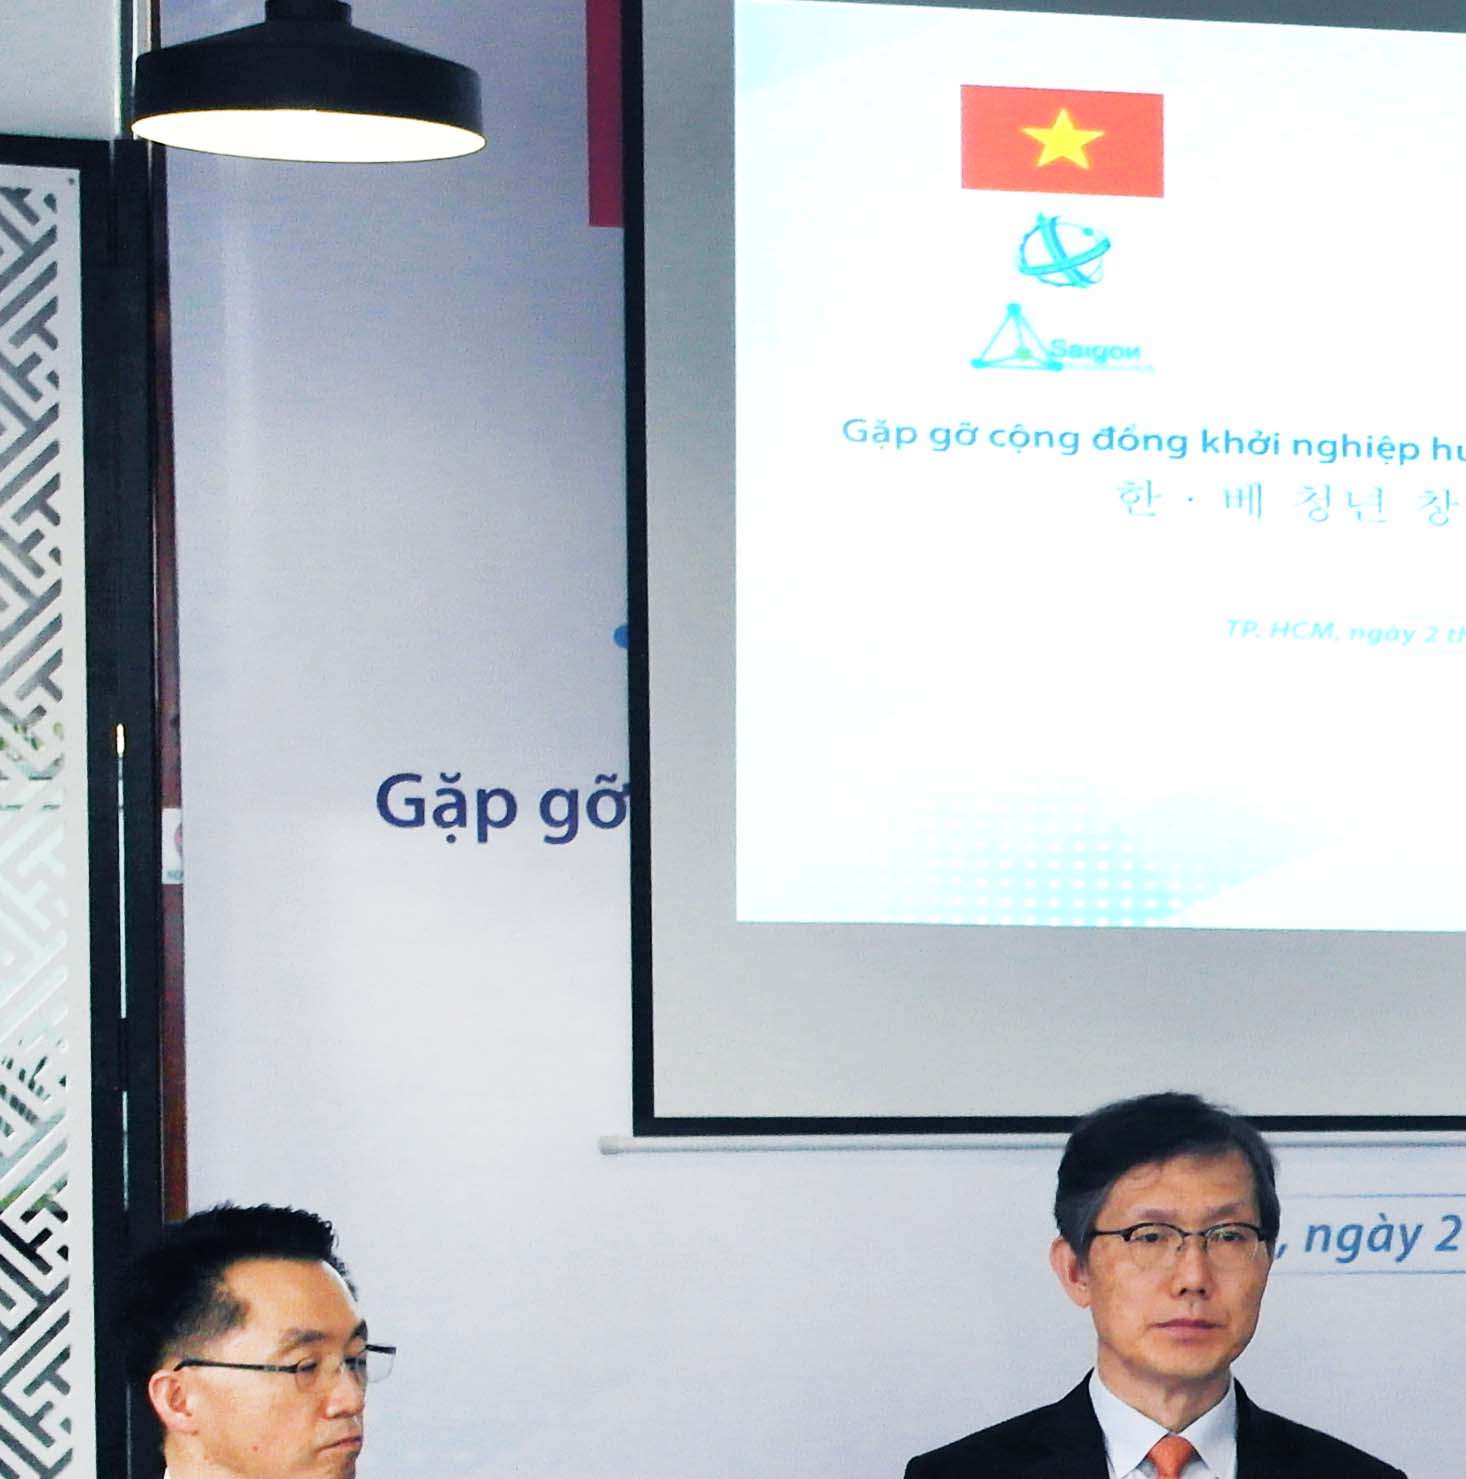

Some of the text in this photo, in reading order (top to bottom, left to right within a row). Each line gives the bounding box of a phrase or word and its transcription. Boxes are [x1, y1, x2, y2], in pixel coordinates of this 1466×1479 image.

[989, 423, 1080, 455] cộng
[1292, 432, 1421, 466] nghiệp
[1114, 479, 1163, 519] 한
[1222, 481, 1263, 521] 베
[1296, 483, 1388, 525] 청년
[1423, 626, 1440, 645] 2
[376, 772, 631, 845] Gặp gỡ
[1305, 1212, 1424, 1264] ngày
[1435, 1213, 1463, 1251] 2
